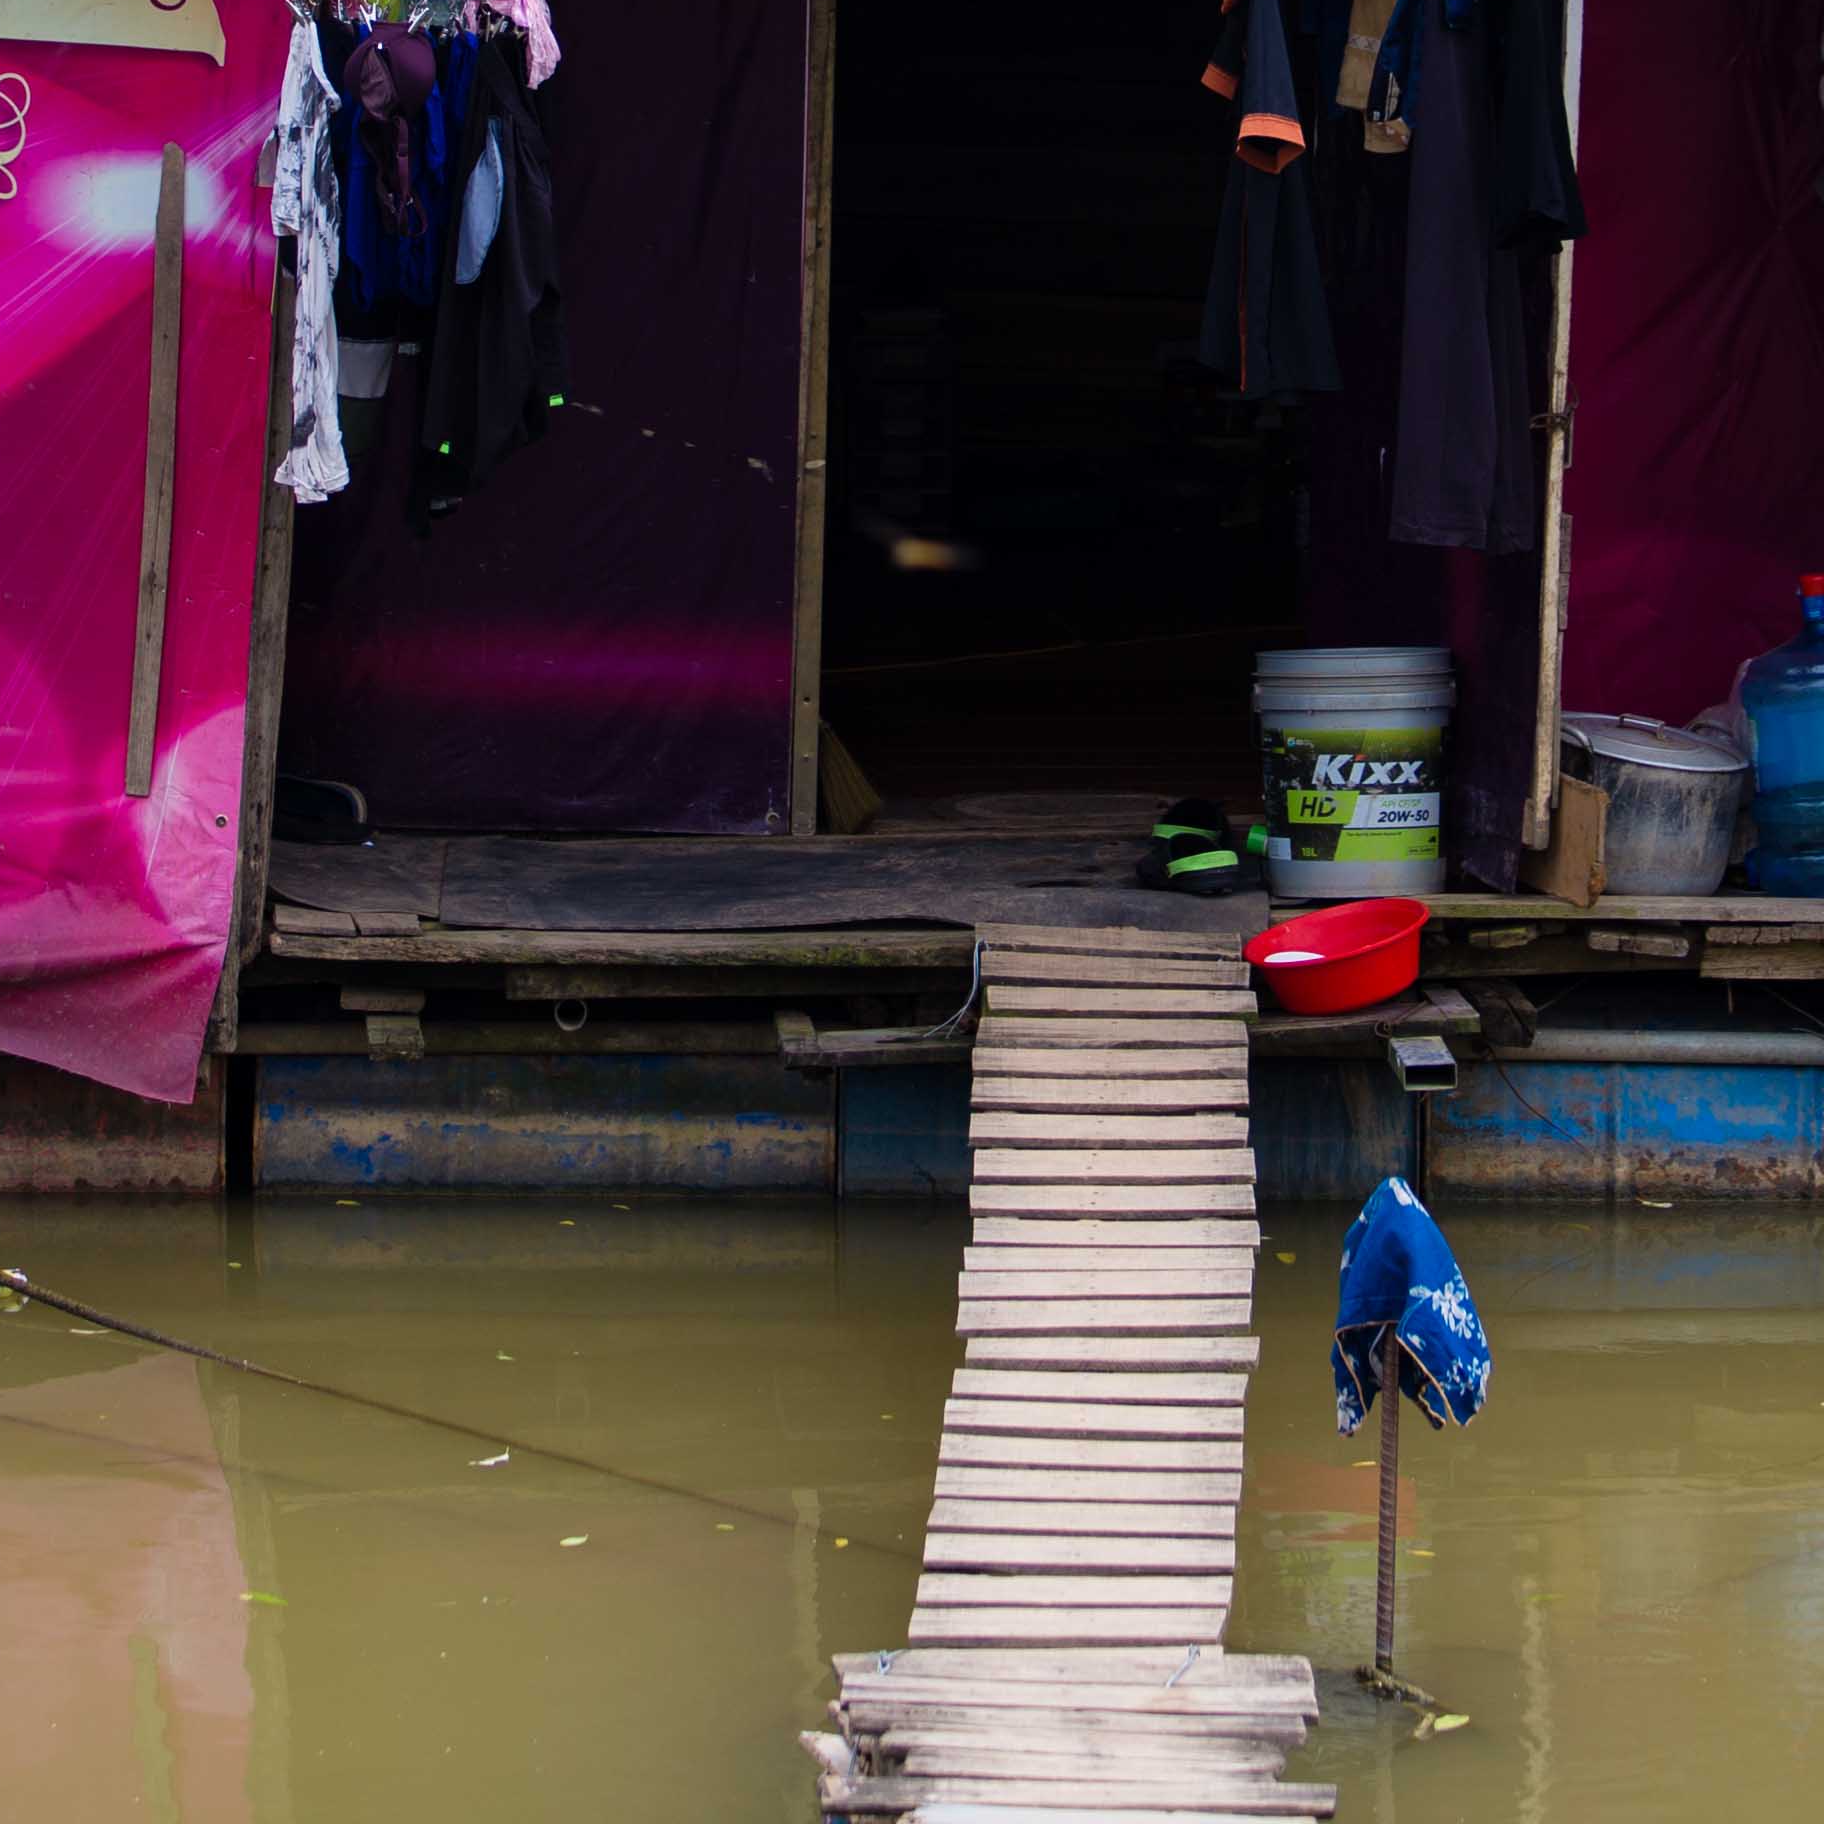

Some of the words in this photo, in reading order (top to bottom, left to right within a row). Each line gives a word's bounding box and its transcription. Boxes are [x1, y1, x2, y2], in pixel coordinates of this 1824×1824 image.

[1312, 754, 1425, 786] Kixx
[1300, 797, 1337, 817] HD
[1378, 810, 1430, 823] 20W-50
